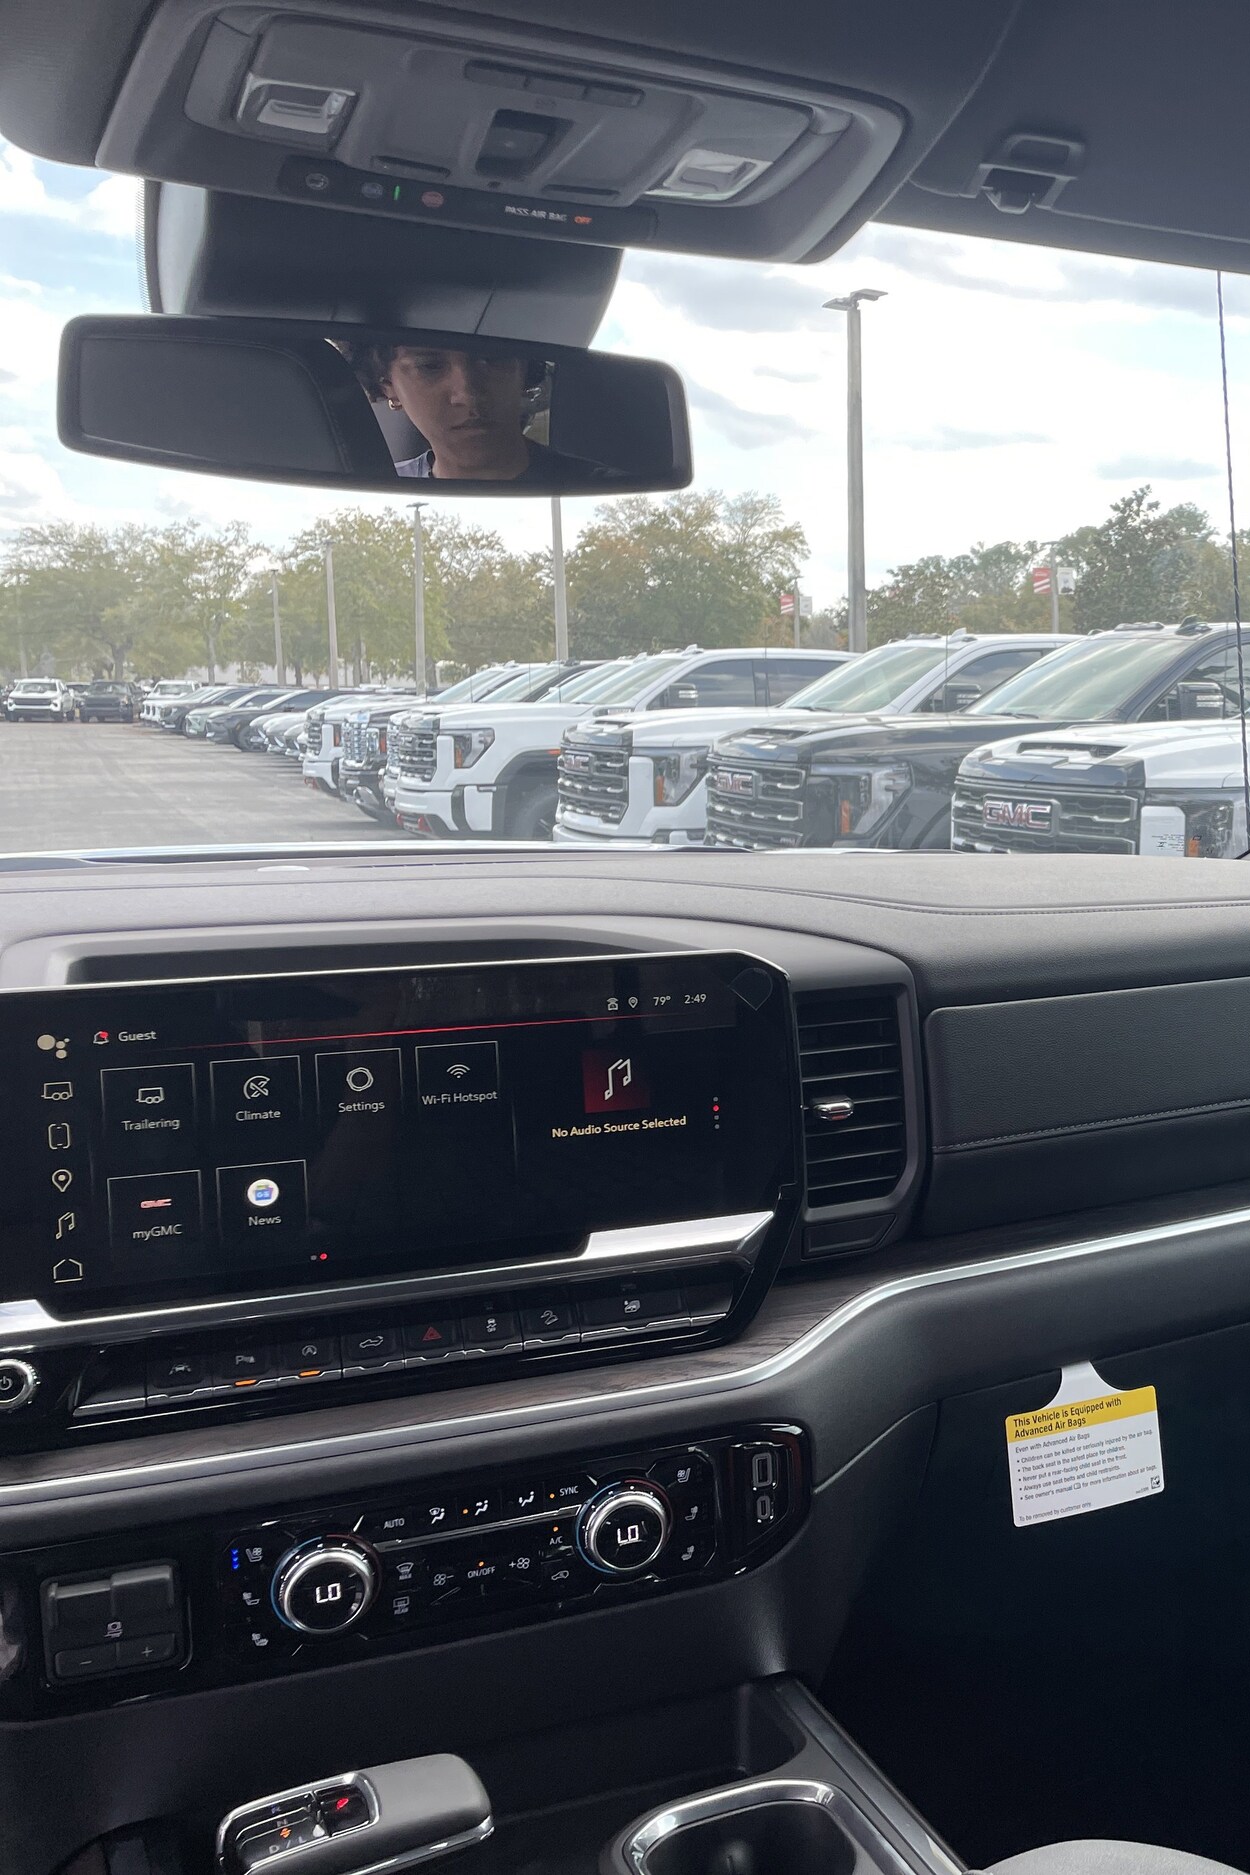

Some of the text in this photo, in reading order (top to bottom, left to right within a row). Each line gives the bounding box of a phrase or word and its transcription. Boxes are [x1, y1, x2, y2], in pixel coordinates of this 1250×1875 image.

[531, 210, 547, 219] AIR
[713, 772, 753, 795] GMC
[984, 800, 1051, 828] GMC
[684, 994, 707, 1004] 2:49
[118, 1030, 157, 1042] Guest
[421, 1091, 498, 1105] Wi-Fi Hotspot
[338, 1101, 385, 1113] Settings
[235, 1110, 281, 1121] Climate
[121, 1119, 180, 1131] Trailering
[551, 1115, 687, 1138] No Audio Source Selected
[248, 1216, 282, 1226] News
[132, 1224, 182, 1241] myGMC
[1014, 1397, 1122, 1428] This Vehicle is Equipped with
[1014, 1417, 1086, 1439] Advanced Air Bags
[1015, 1446, 1029, 1454] Even
[1030, 1442, 1042, 1450] with
[1043, 1437, 1068, 1448] Advanced
[1077, 1432, 1090, 1440] Bags
[1021, 1455, 1043, 1464] Children
[1062, 1447, 1076, 1455] killed
[1083, 1440, 1104, 1450] seriously
[1086, 1451, 1099, 1460] place
[1022, 1474, 1038, 1482] Never
[1038, 1472, 1047, 1480] put
[1052, 1466, 1079, 1476] rear-facing
[1052, 1478, 1063, 1486] seat
[1086, 1470, 1098, 1478] child
[1055, 1485, 1073, 1494] manual
[1102, 1472, 1127, 1483] information
[1127, 1468, 1139, 1477] about
[559, 1485, 579, 1497] SYNC
[1060, 1504, 1081, 1513] customer
[383, 1518, 405, 1530] AUTO
[549, 1536, 563, 1546] A/C
[616, 1525, 639, 1546] LO
[467, 1566, 496, 1579] ON/OFF
[315, 1583, 341, 1604] LO
